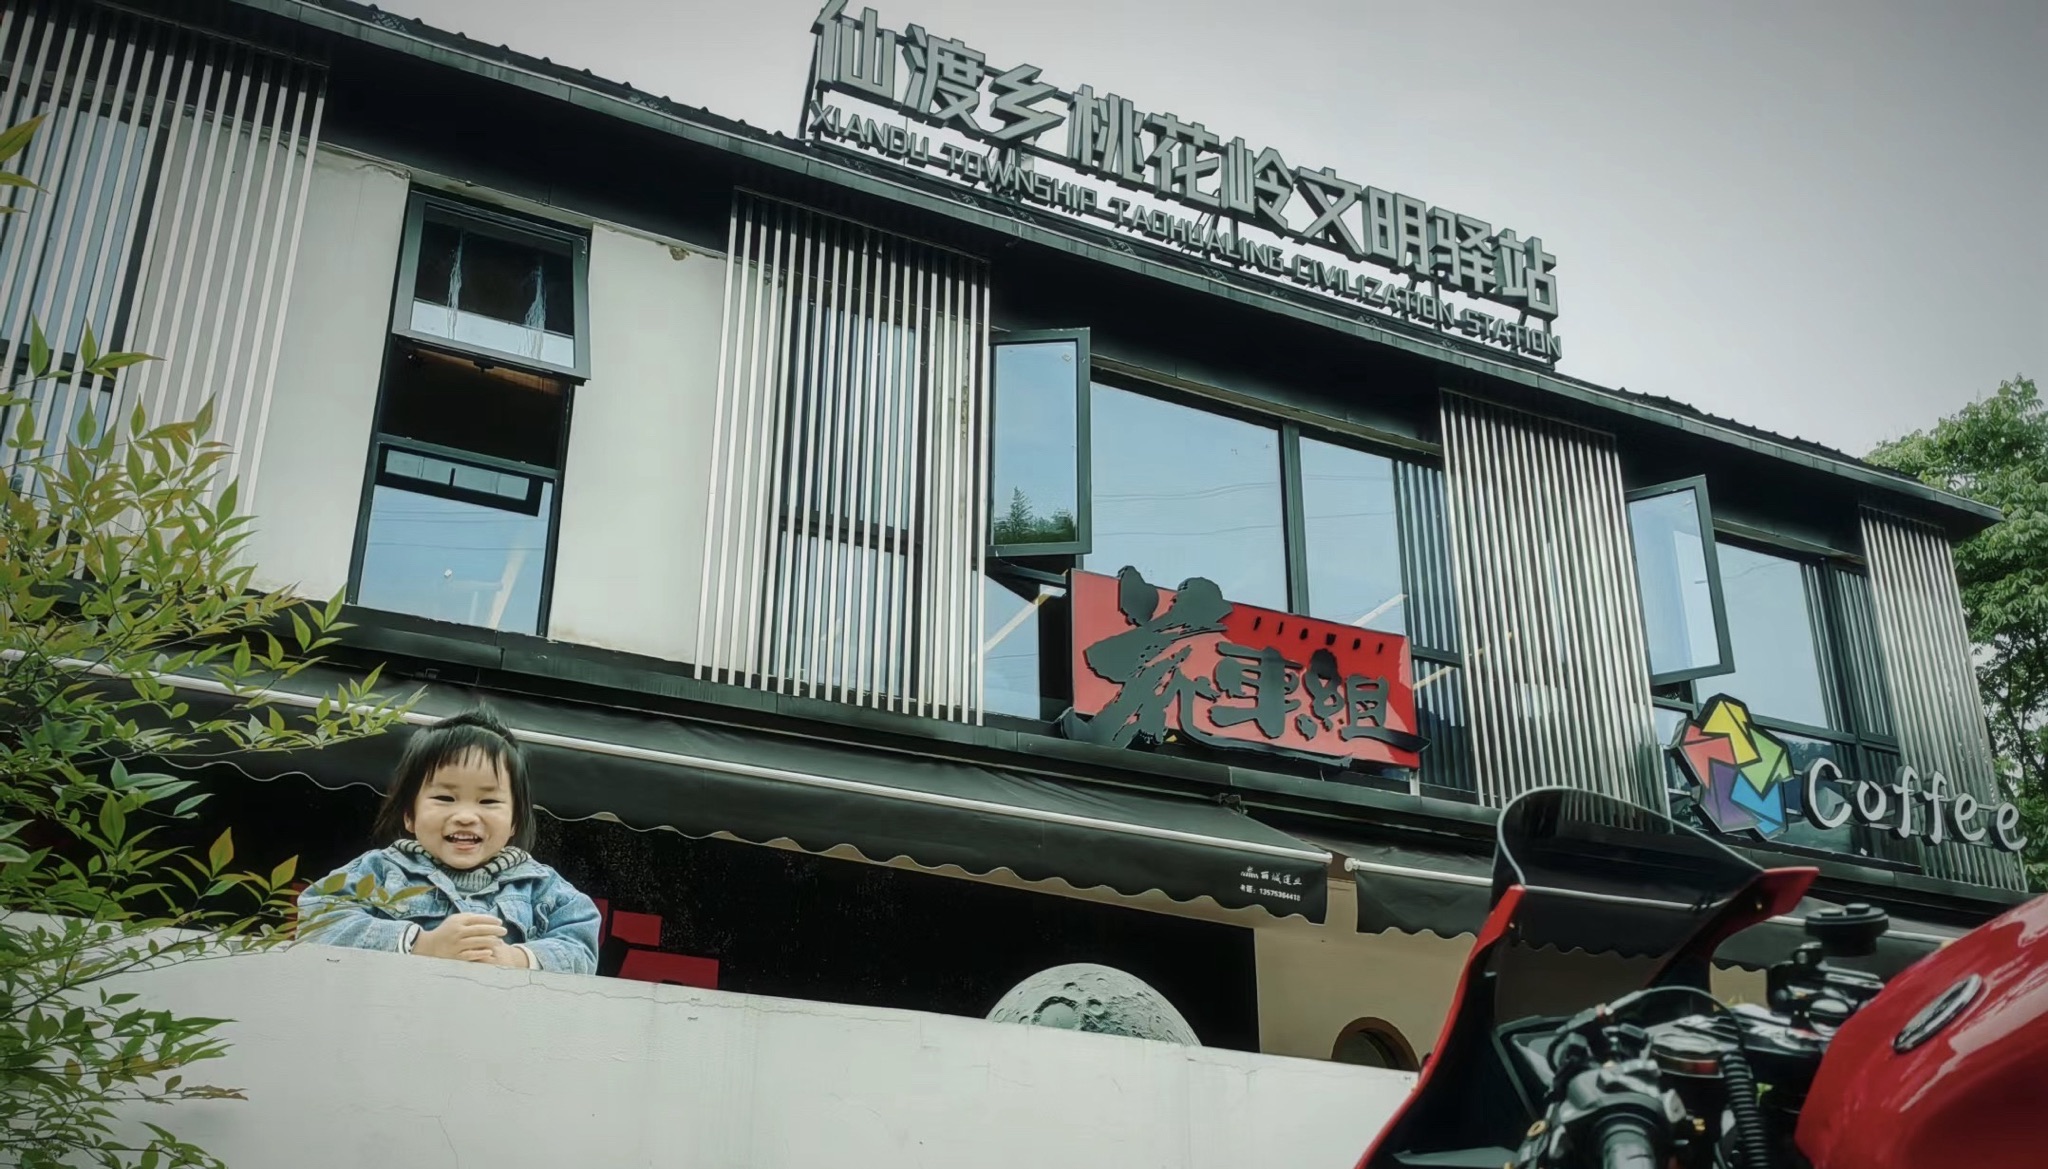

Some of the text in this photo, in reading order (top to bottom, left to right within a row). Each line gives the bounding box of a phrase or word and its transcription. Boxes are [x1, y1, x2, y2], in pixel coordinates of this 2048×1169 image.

[809, 100, 1562, 361] XIANDU TOWNSHIP TAOHUALING CIVILIZATION STATION
[810, 0, 1558, 320] 仙渡乡桃花岭文明驿站
[1802, 756, 2028, 852] Coffee
